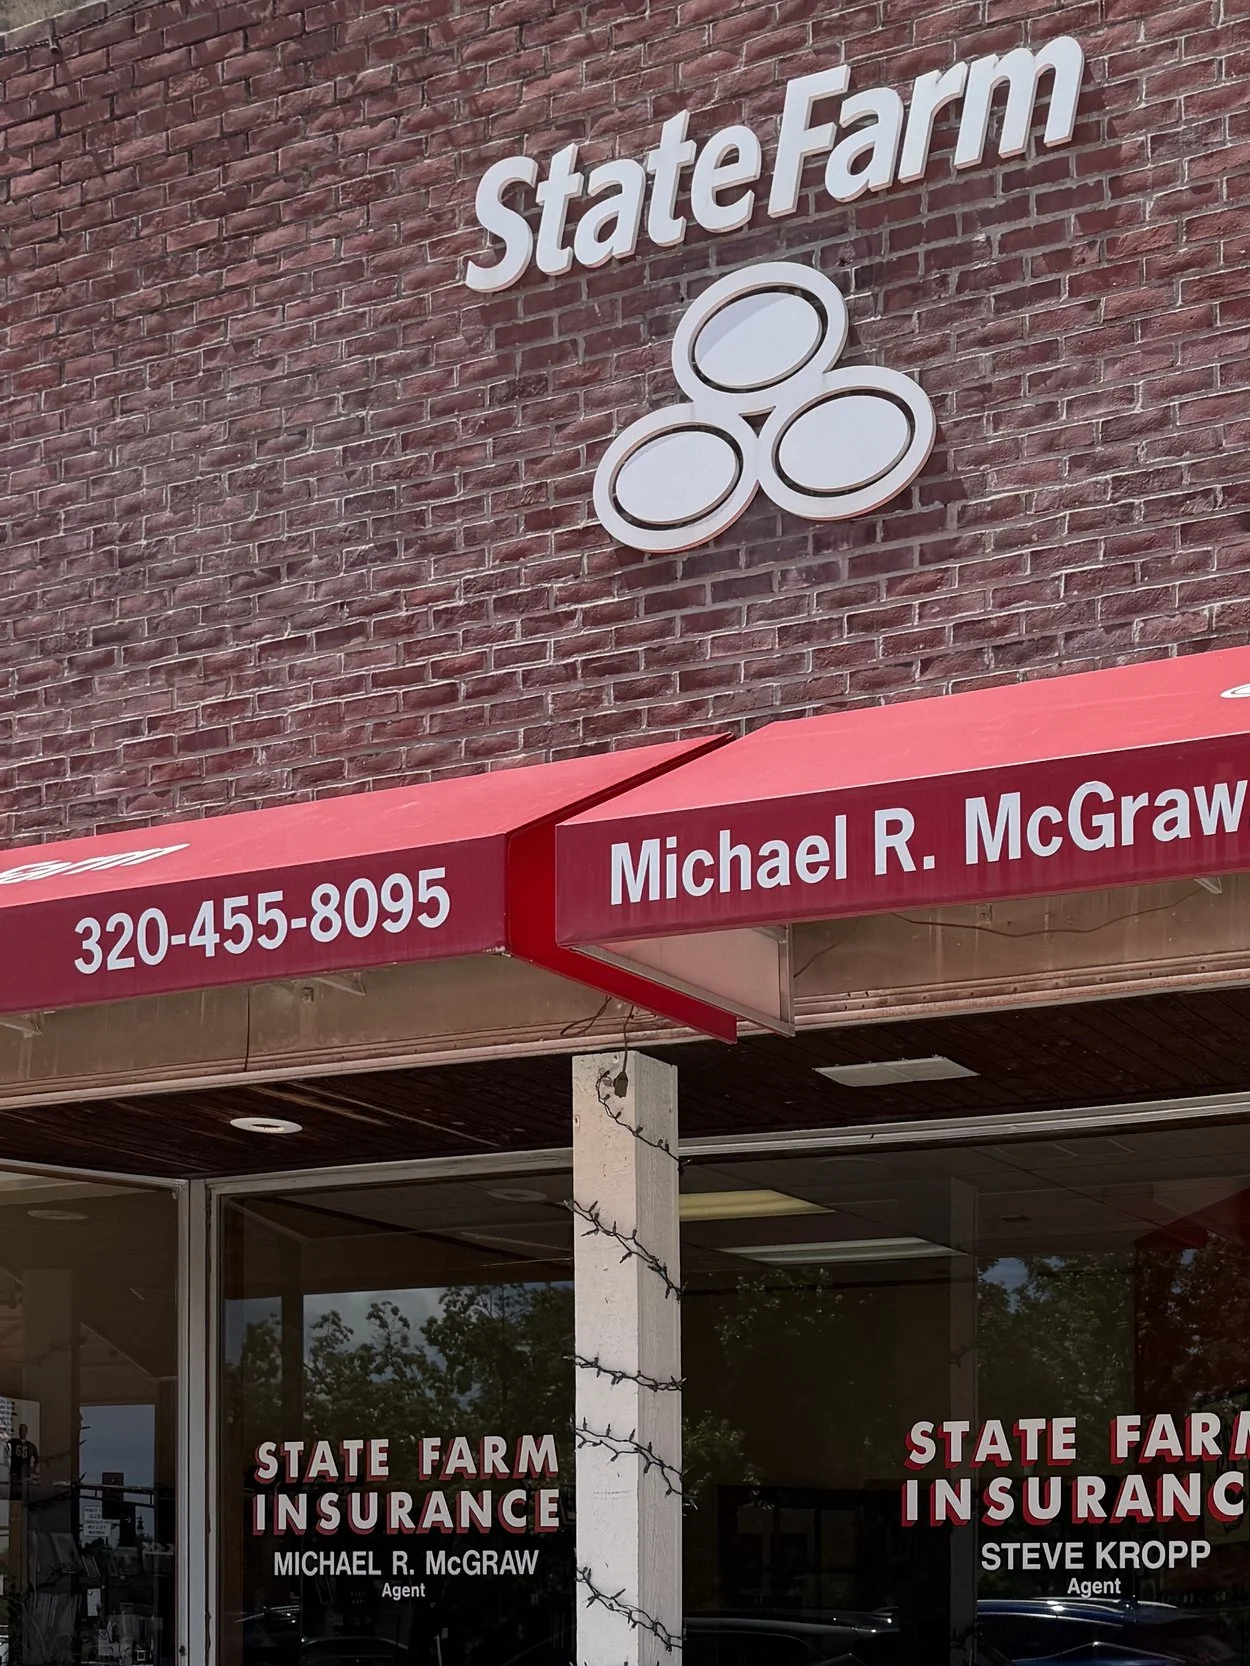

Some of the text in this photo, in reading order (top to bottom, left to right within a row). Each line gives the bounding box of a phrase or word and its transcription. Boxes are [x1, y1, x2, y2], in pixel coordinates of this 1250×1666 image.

[610, 811, 848, 906] Michael
[874, 808, 935, 876] R.
[74, 867, 450, 975] 320-455-8095
[255, 1434, 559, 1484] STATE FARM
[904, 1416, 1078, 1471] STATE
[253, 1488, 560, 1536] INSURANCE
[274, 1549, 540, 1577] MICHAEL R. McGRAW
[980, 1540, 1212, 1571] STEVE KROPP
[381, 1582, 426, 1600] Agent
[1067, 1576, 1122, 1598] Agent
